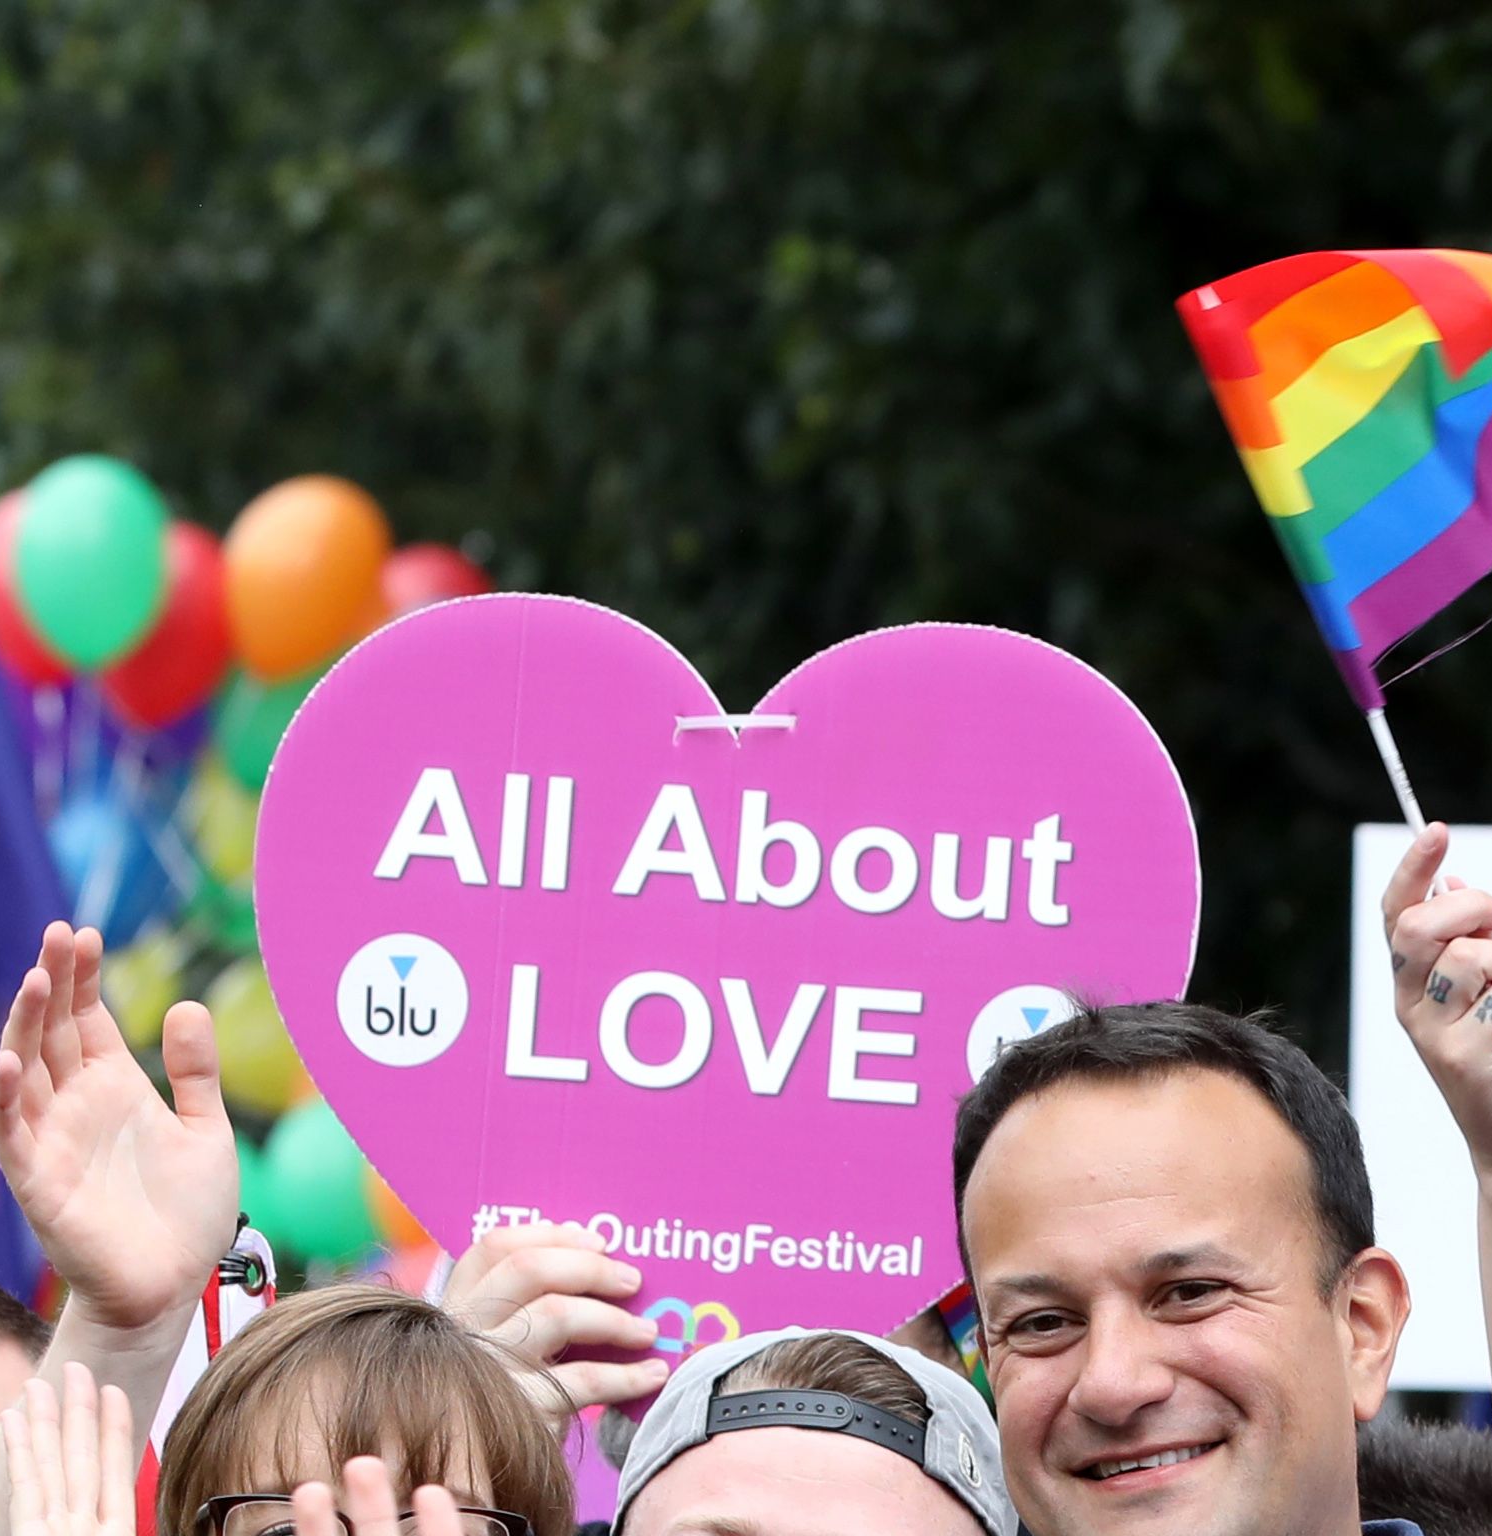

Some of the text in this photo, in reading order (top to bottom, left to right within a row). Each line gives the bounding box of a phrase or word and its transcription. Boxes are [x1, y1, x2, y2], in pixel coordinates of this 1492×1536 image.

[373, 766, 1074, 927] All About
[366, 984, 437, 1037] blu
[505, 963, 924, 1105] LOVE
